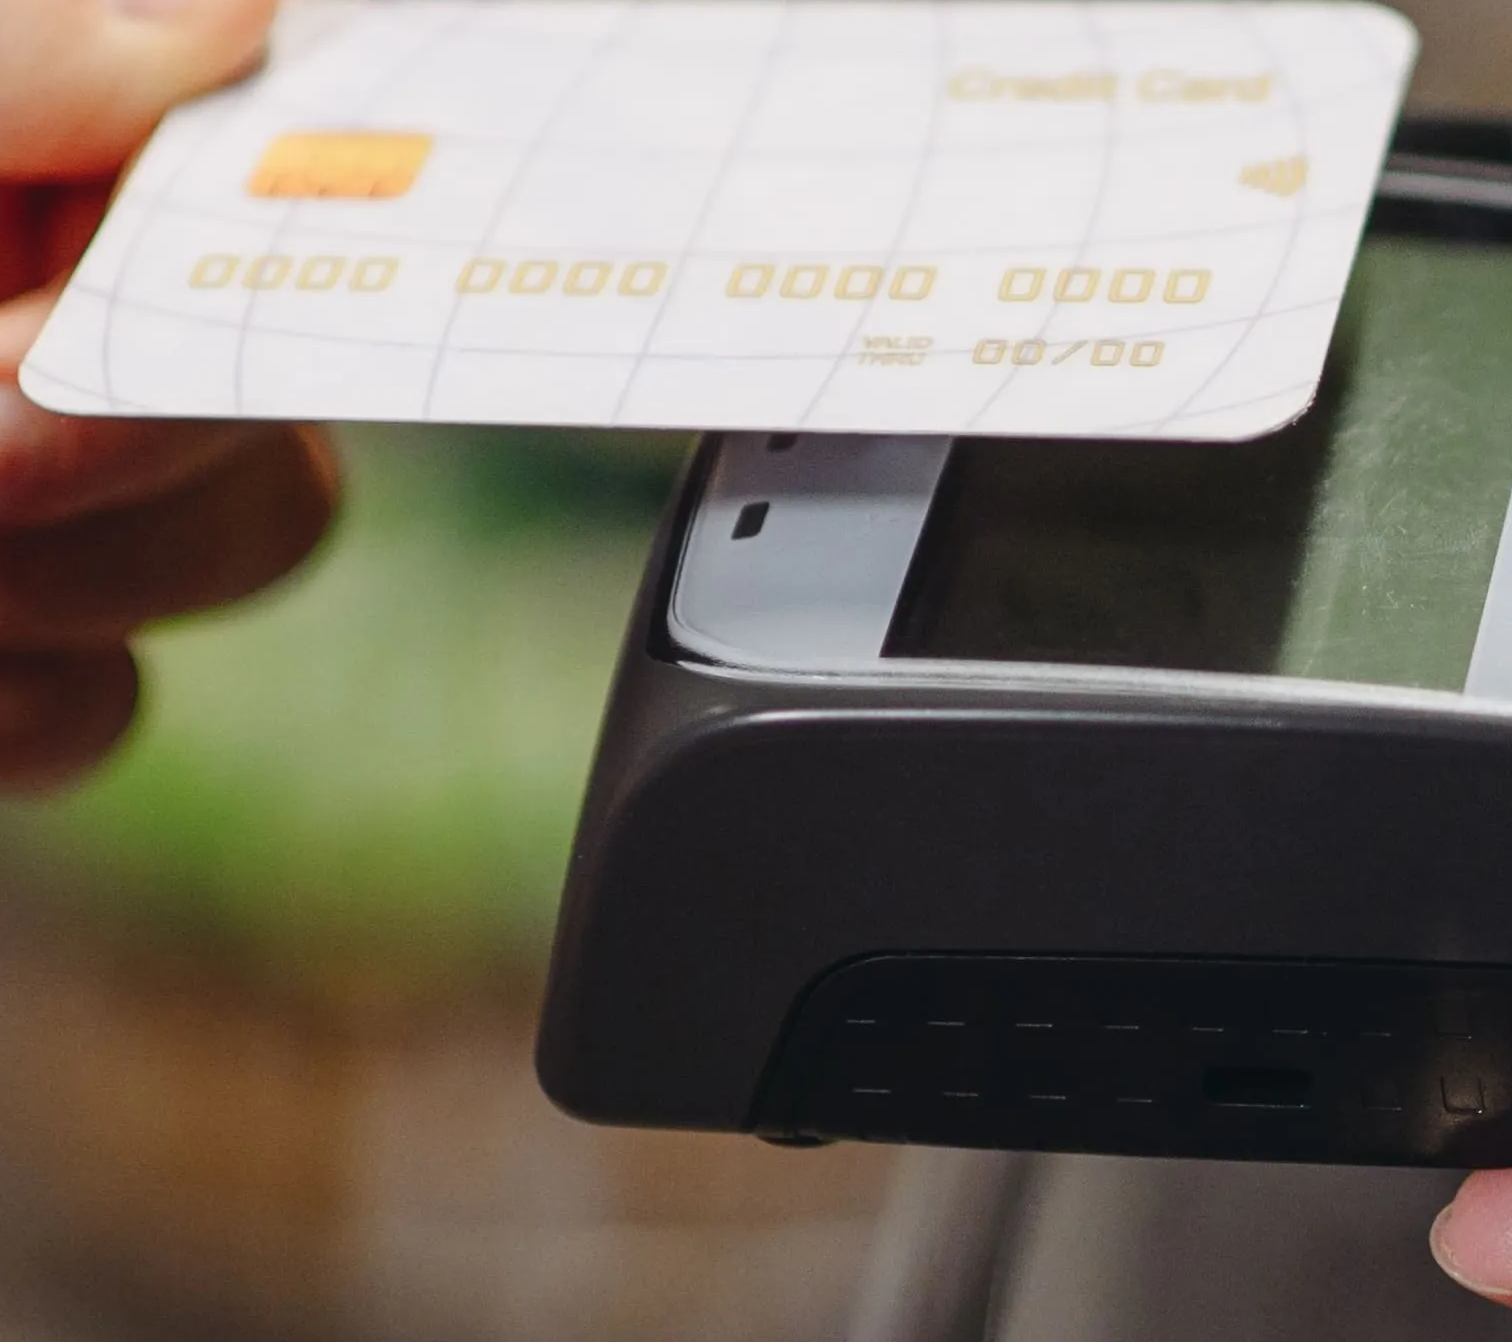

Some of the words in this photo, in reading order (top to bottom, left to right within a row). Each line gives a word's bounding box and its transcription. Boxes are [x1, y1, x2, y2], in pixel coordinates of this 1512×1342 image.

[1136, 68, 1276, 103] Card
[188, 255, 400, 293] 0000
[455, 258, 669, 297] 0000
[724, 263, 938, 301] 0000
[996, 266, 1213, 305] 0000
[862, 336, 934, 350] VALID
